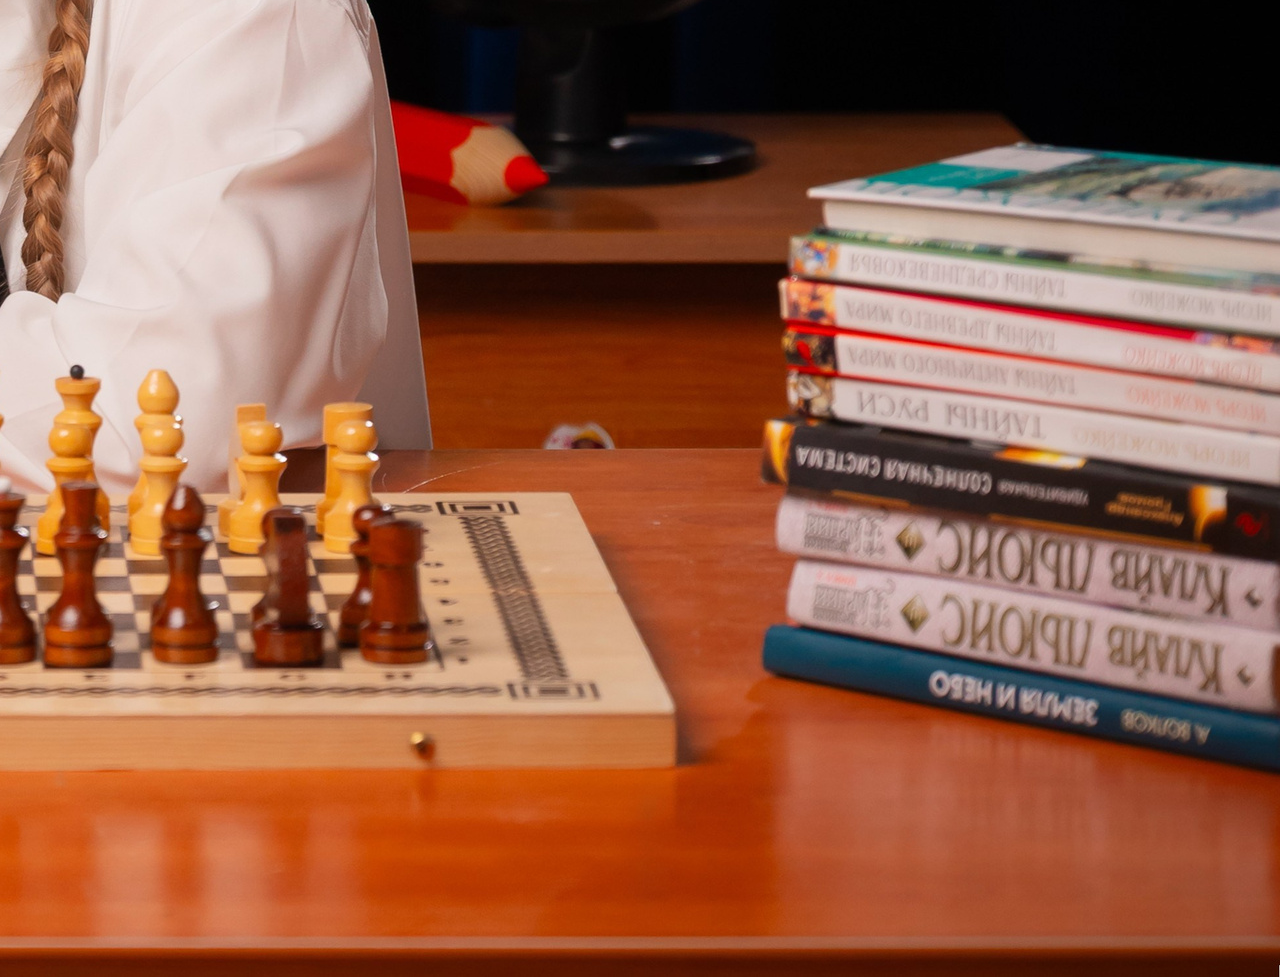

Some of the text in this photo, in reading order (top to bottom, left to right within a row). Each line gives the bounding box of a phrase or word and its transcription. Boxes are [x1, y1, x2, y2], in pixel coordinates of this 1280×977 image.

[1005, 272, 1069, 301] ТАЙНЫ
[844, 300, 896, 323] МИРА
[996, 324, 1060, 353] ТАЙНЫ
[846, 347, 897, 370] МИРА
[856, 390, 1048, 441] ТАЙНЫ РУСИ
[795, 444, 882, 478] СИСТЕМА
[882, 457, 993, 495] СОЛНЕЧНАЯ
[936, 520, 1097, 594] ЛЬЮИС
[940, 593, 1095, 669] ЛЬЮИС
[928, 668, 1100, 728] ЗЕМЛЯ И НЕБО
[1120, 707, 1193, 743] ВОЛКОВ
